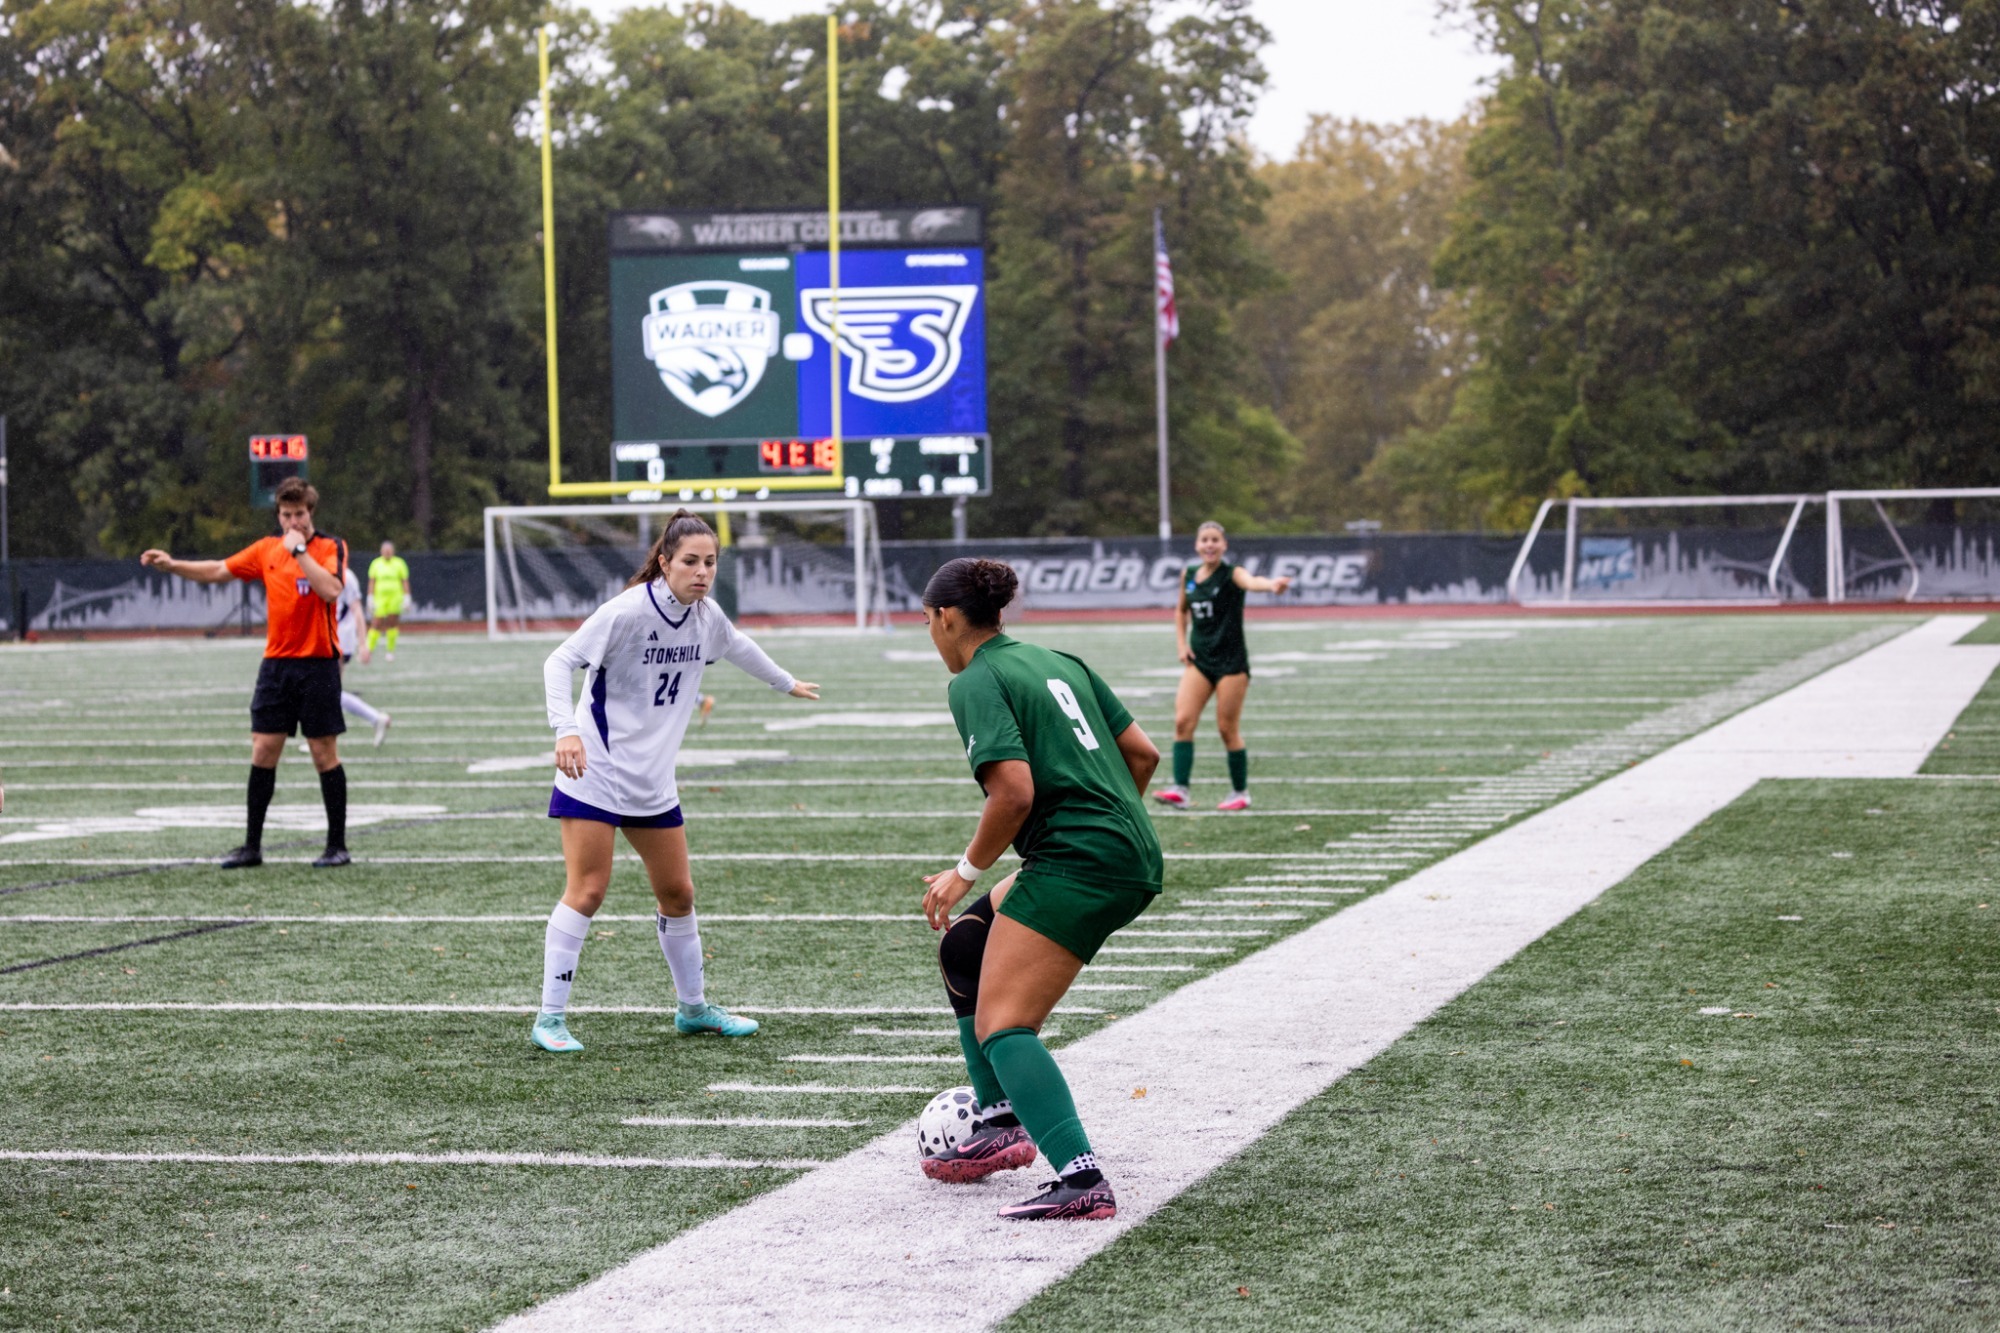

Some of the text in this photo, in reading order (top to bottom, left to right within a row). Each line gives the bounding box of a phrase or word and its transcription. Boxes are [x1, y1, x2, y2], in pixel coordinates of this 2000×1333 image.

[693, 222, 796, 245] WAGNER
[656, 320, 765, 339] WAGNER
[1191, 601, 1213, 618] 27
[642, 644, 701, 665] STONEHILL
[654, 671, 682, 707] 24
[1047, 678, 1100, 751] 9
